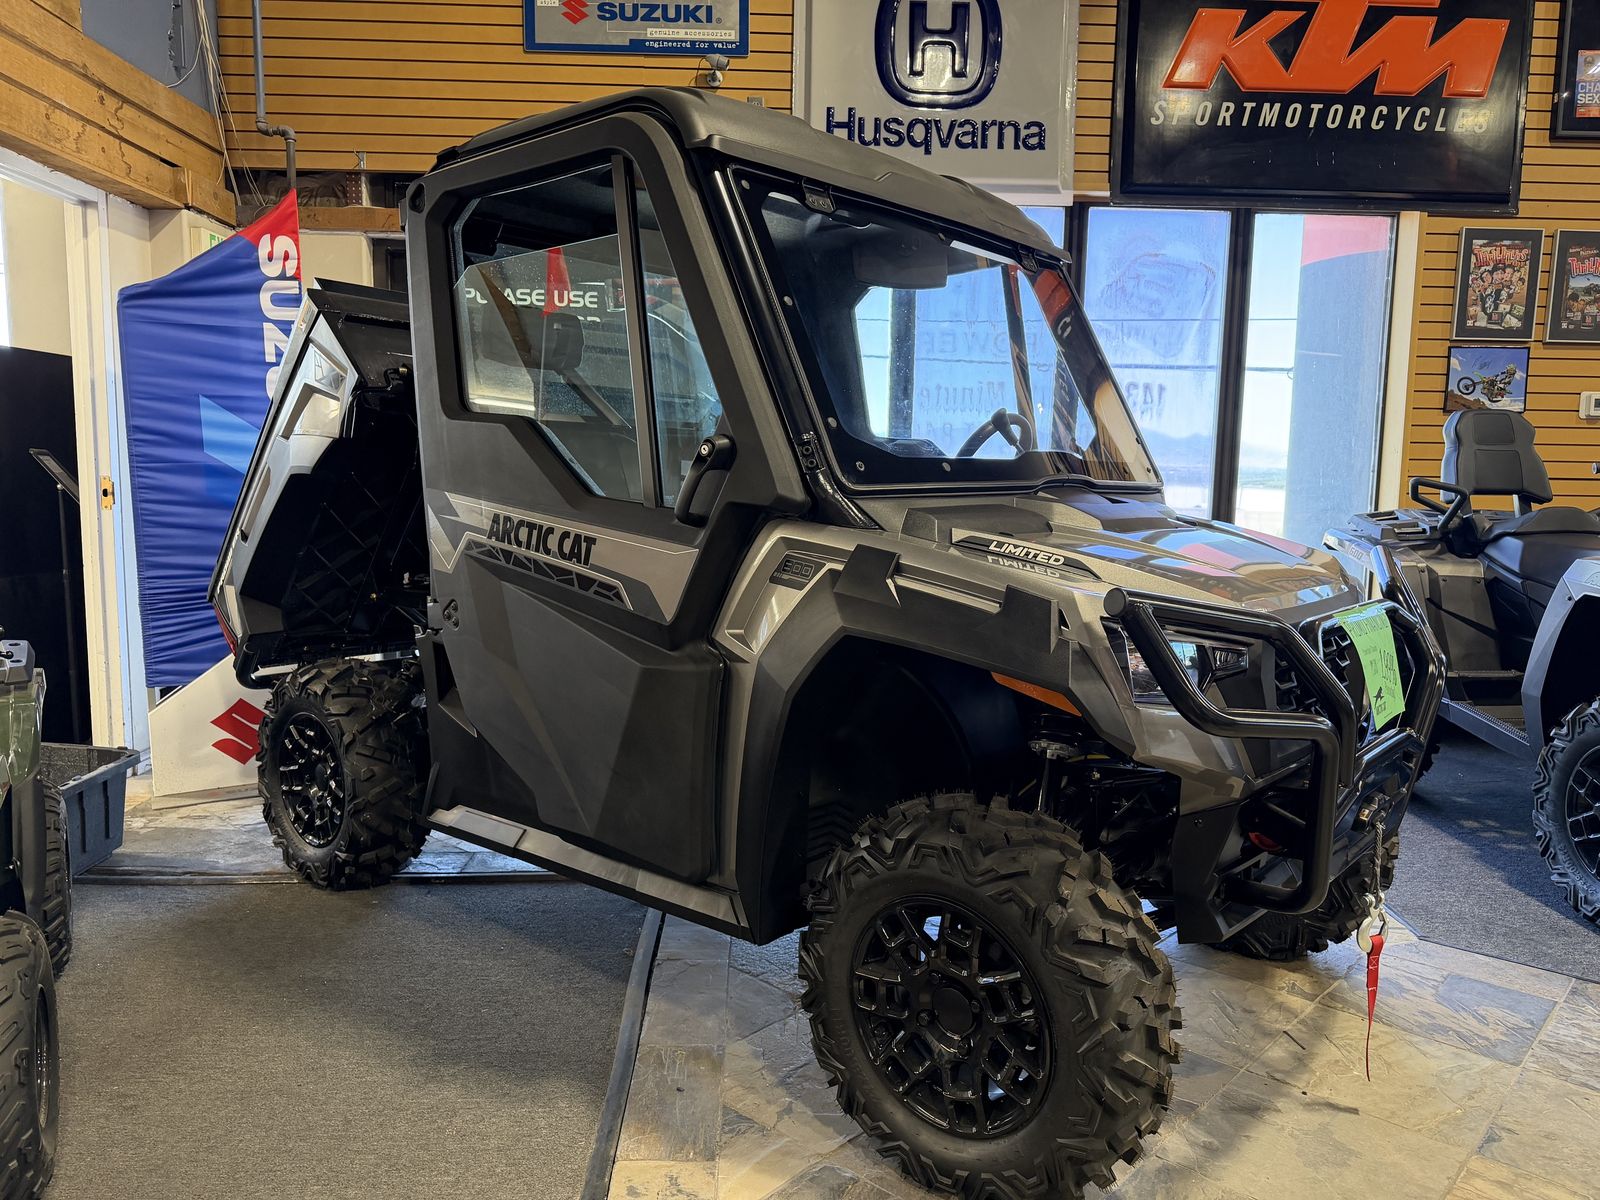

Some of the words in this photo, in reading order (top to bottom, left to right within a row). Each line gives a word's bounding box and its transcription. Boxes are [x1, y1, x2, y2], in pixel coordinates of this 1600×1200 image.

[597, 2, 713, 24] SUZUKI
[645, 41, 691, 49] engineered
[684, 30, 733, 38] accessories
[1161, 0, 1510, 98] KTM
[1150, 100, 1490, 134] SPORTMOTORCYCLES
[825, 106, 1046, 155] Husqvarna
[465, 287, 545, 306] PLASE
[553, 290, 598, 308] USE
[487, 512, 555, 556] ARCTIC
[557, 530, 598, 568] CAT
[988, 540, 1065, 566] LIMITED
